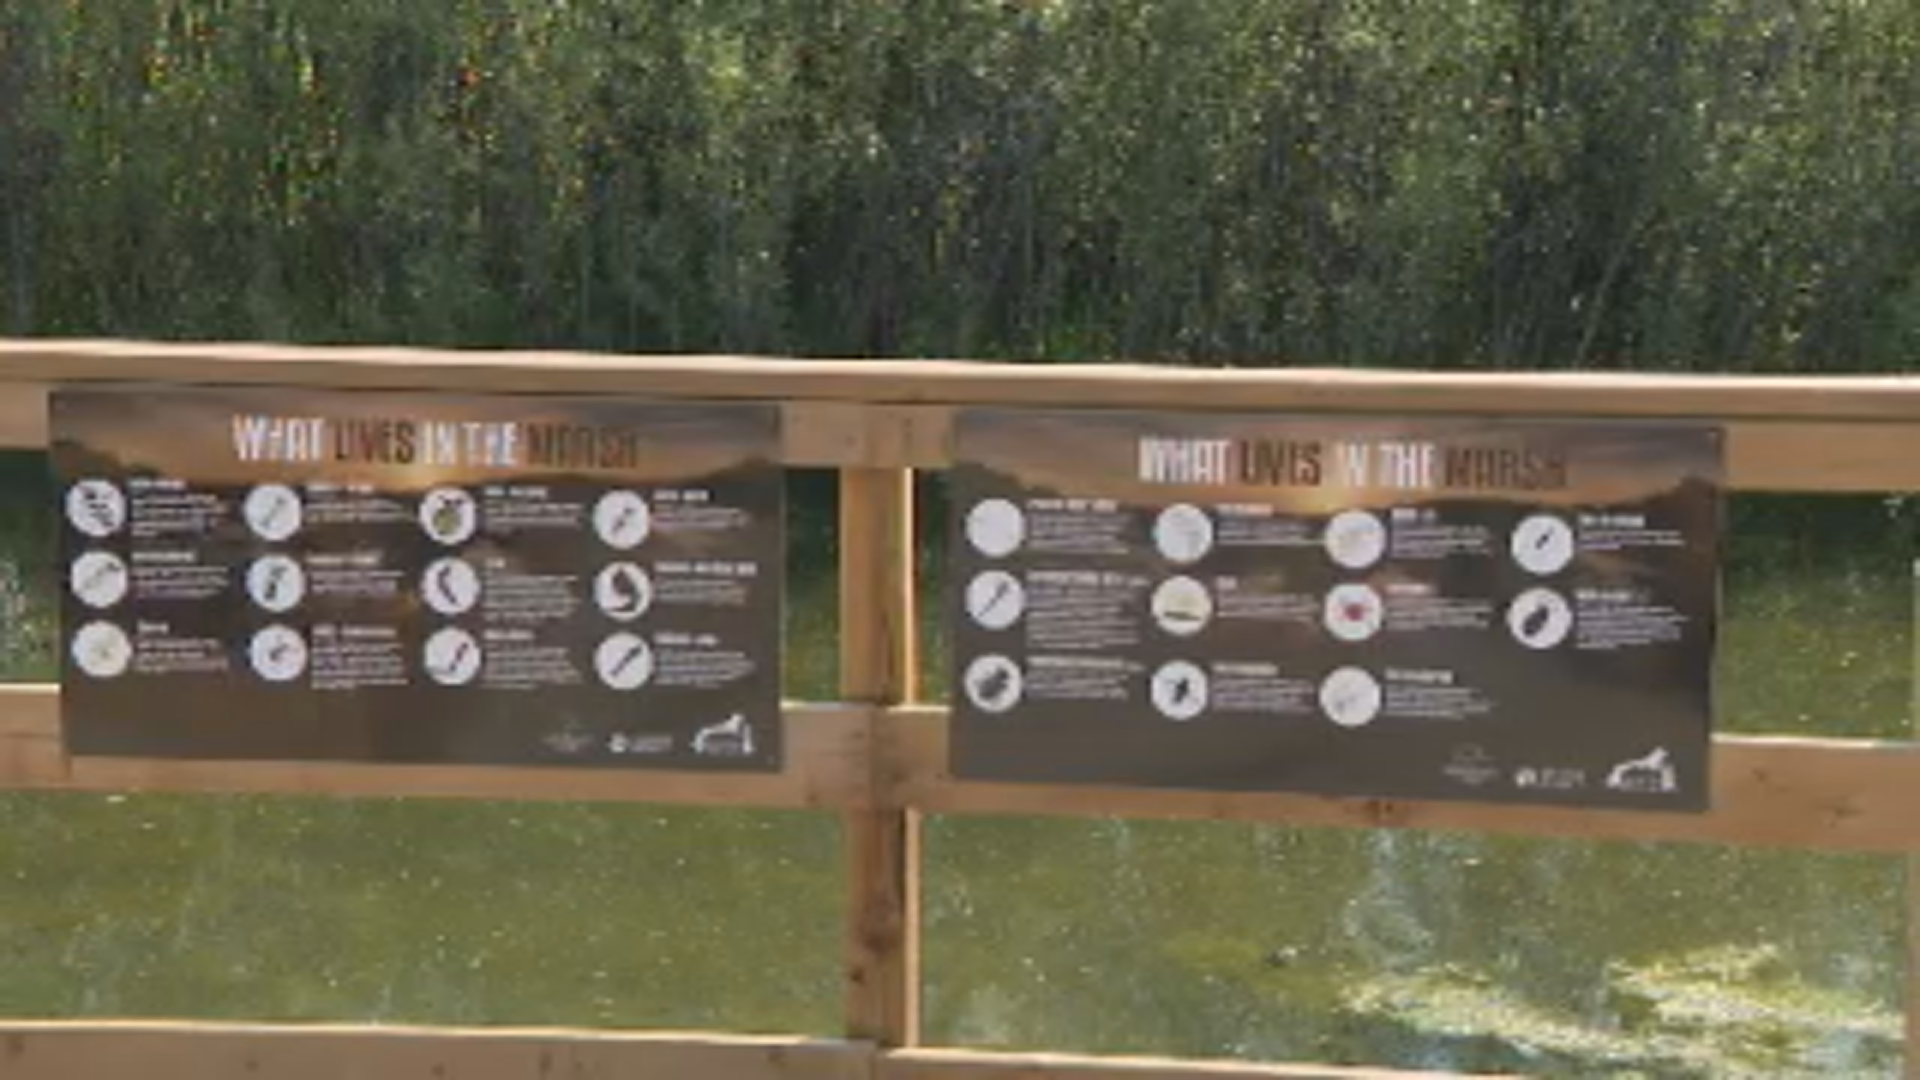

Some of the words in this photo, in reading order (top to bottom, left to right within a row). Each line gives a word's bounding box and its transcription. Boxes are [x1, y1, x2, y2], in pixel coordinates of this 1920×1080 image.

[233, 414, 324, 463] WHAT
[462, 422, 517, 466] THE
[1138, 437, 1230, 484] WHAT
[1377, 442, 1435, 488] THE
